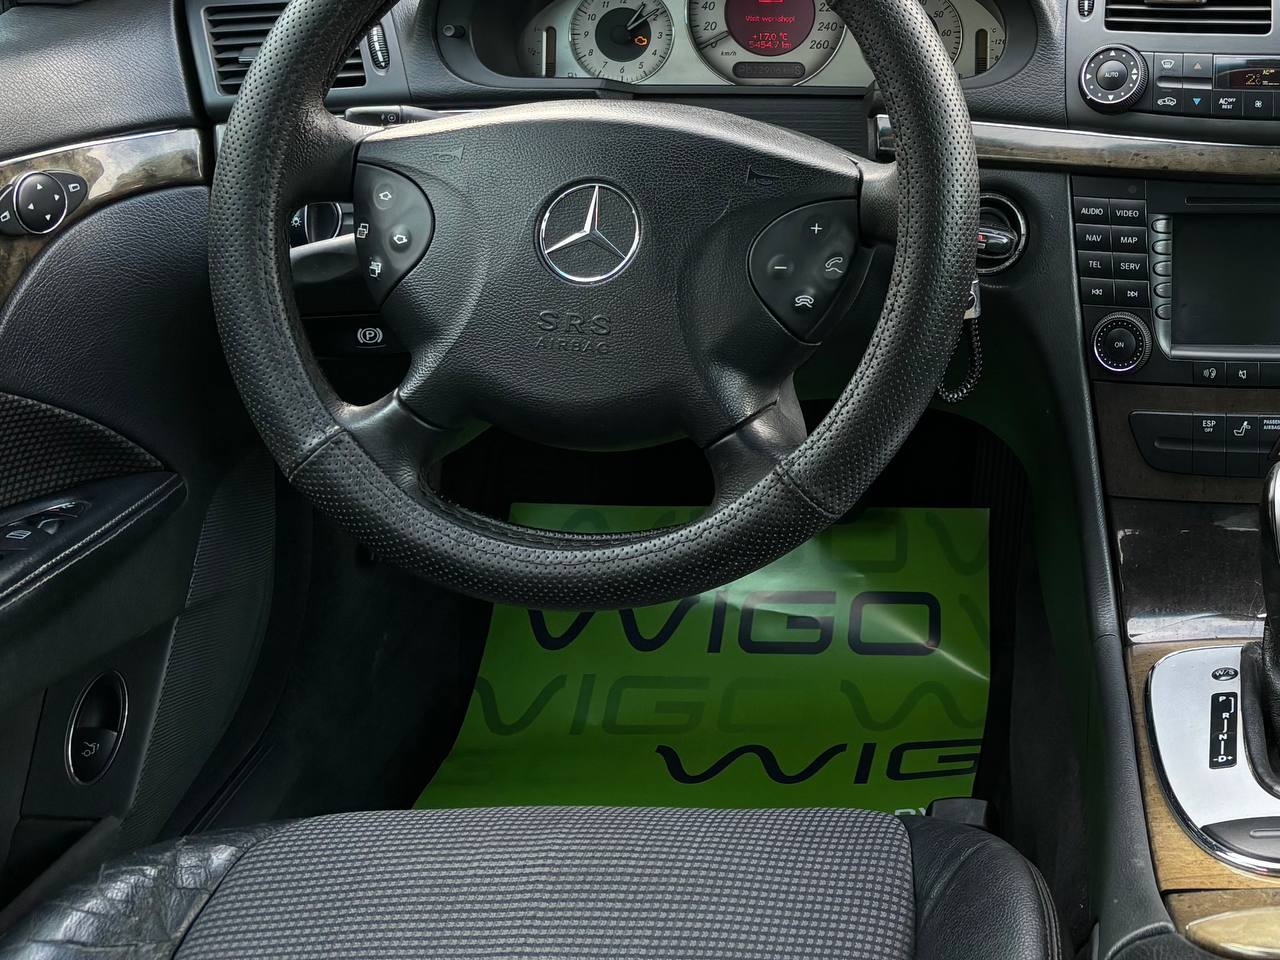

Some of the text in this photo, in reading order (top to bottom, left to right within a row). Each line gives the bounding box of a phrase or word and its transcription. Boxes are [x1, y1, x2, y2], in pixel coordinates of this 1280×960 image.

[702, 2, 715, 10] 40
[933, 10, 944, 18] 50
[704, 22, 717, 30] 20
[818, 22, 838, 31] 240
[941, 29, 952, 37] 60
[809, 40, 829, 49] 260
[539, 310, 611, 335] SRS
[528, 590, 942, 657] WIGO
